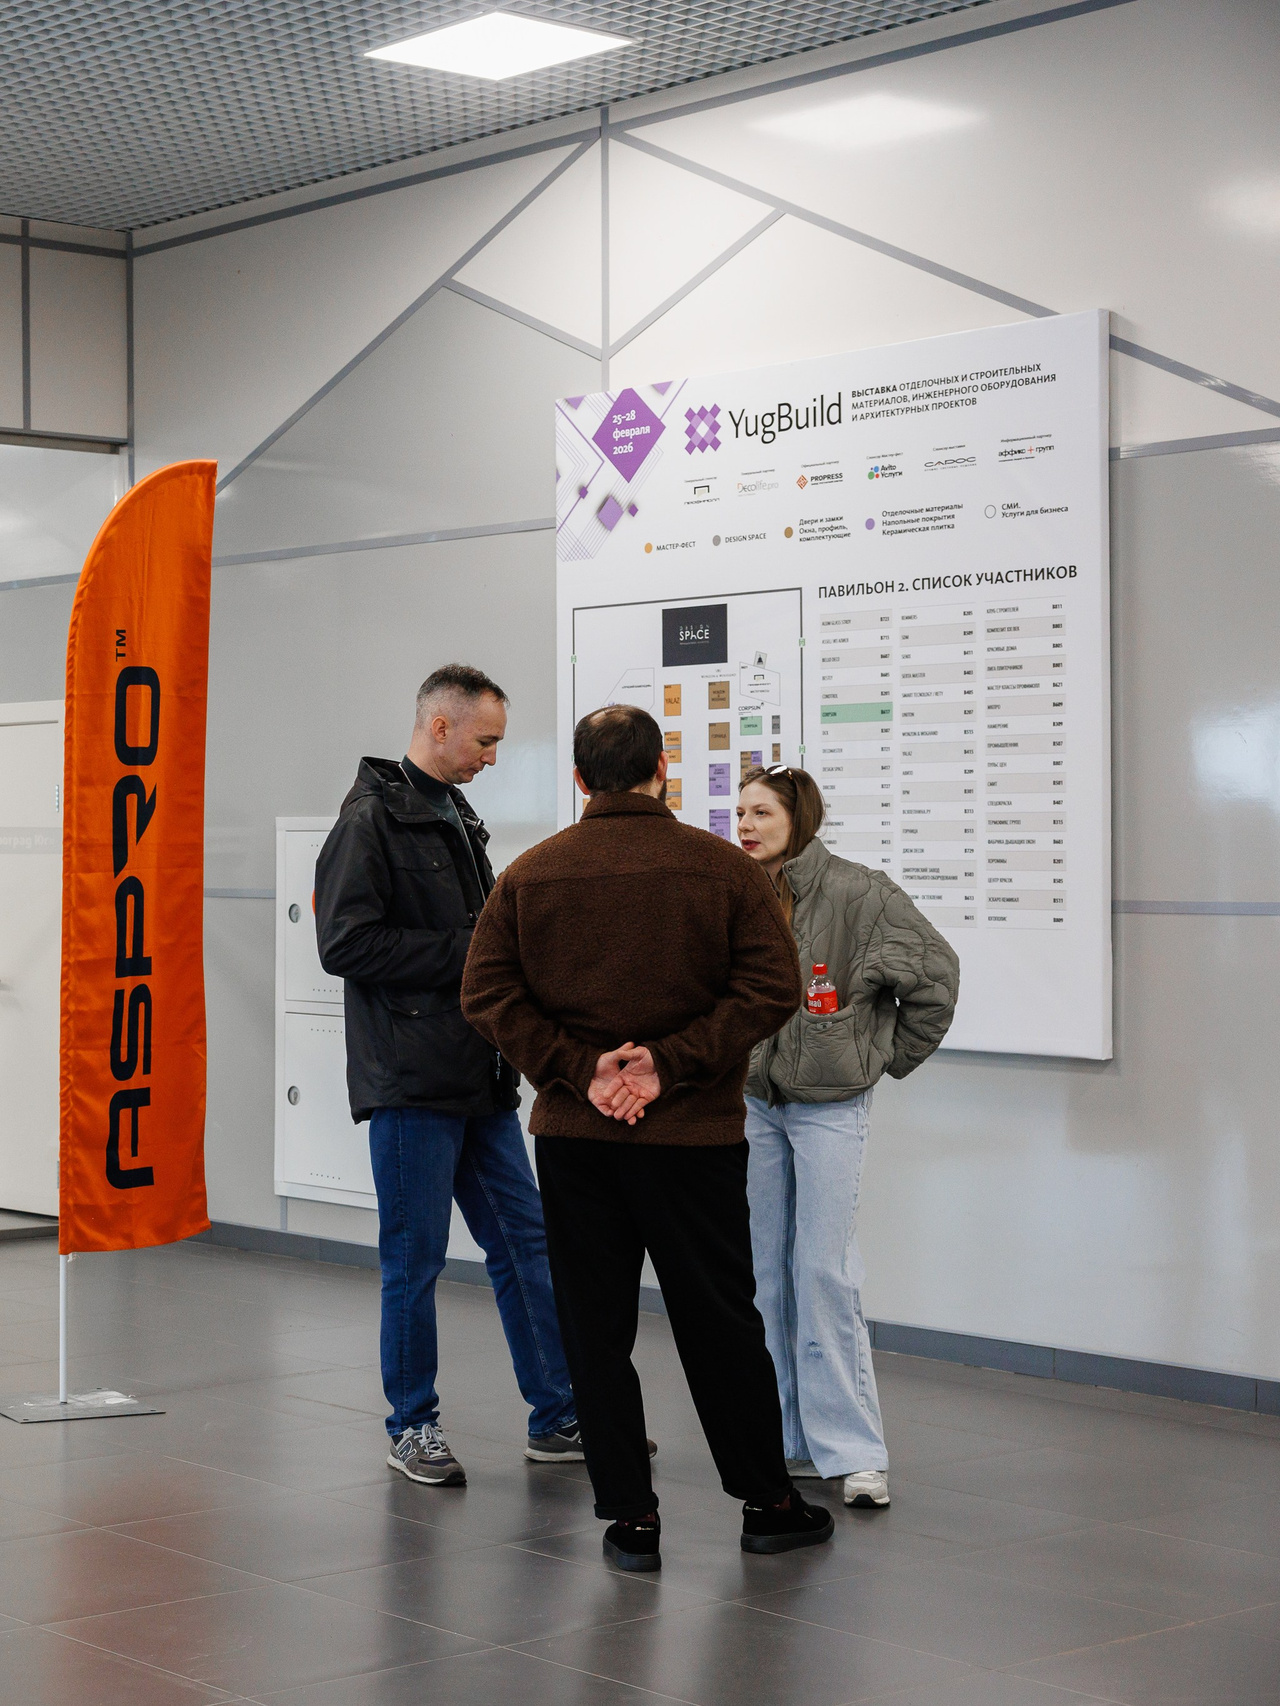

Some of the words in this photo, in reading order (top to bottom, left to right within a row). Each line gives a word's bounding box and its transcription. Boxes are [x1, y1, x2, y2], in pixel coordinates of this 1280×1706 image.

[851, 385, 898, 400] ВЫСТАВКА
[899, 375, 960, 392] ОТДЕЛОЧНЫХ
[961, 374, 968, 382] И
[969, 363, 1042, 381] СТРОИТЕЛЬНЫХ
[851, 395, 911, 411] МАТЕРИАЛОВ,
[911, 384, 979, 402] ИНЖЕНЕРНОГО
[980, 373, 1057, 392] ОБОРУДОВАНИЯ
[851, 414, 858, 422] И
[859, 404, 930, 421] АРХИТЕКТУРНЫХ
[931, 397, 978, 411] ПРОЕКТОВ
[728, 392, 842, 444] YugBuild
[612, 425, 651, 442] февраля
[612, 443, 634, 455] 2026
[810, 473, 843, 483] PROPRESS
[882, 508, 924, 518] Отделочные
[925, 503, 964, 513] материалы
[1001, 509, 1024, 519] Услуги
[1025, 508, 1038, 516] для
[1039, 505, 1069, 515] бизнеса
[799, 518, 818, 527] Двери
[826, 515, 844, 523] замки
[882, 517, 920, 526] Напольные
[921, 513, 955, 524] покрытия
[799, 527, 817, 535] Окна,
[882, 525, 930, 536] Керамическая
[931, 523, 955, 531] плитка
[725, 534, 747, 544] DESIGN
[748, 533, 767, 542] SPACE
[799, 531, 851, 542] комплектующие
[656, 541, 696, 551] МАСТЕР-ФЕСТ
[818, 580, 895, 599] ПАВИЛЬОН
[898, 582, 909, 593] 2.
[912, 574, 973, 591] СПИСОК
[975, 565, 1078, 586] УЧАСТНИКОВ
[105, 665, 161, 1190] ASPRO
